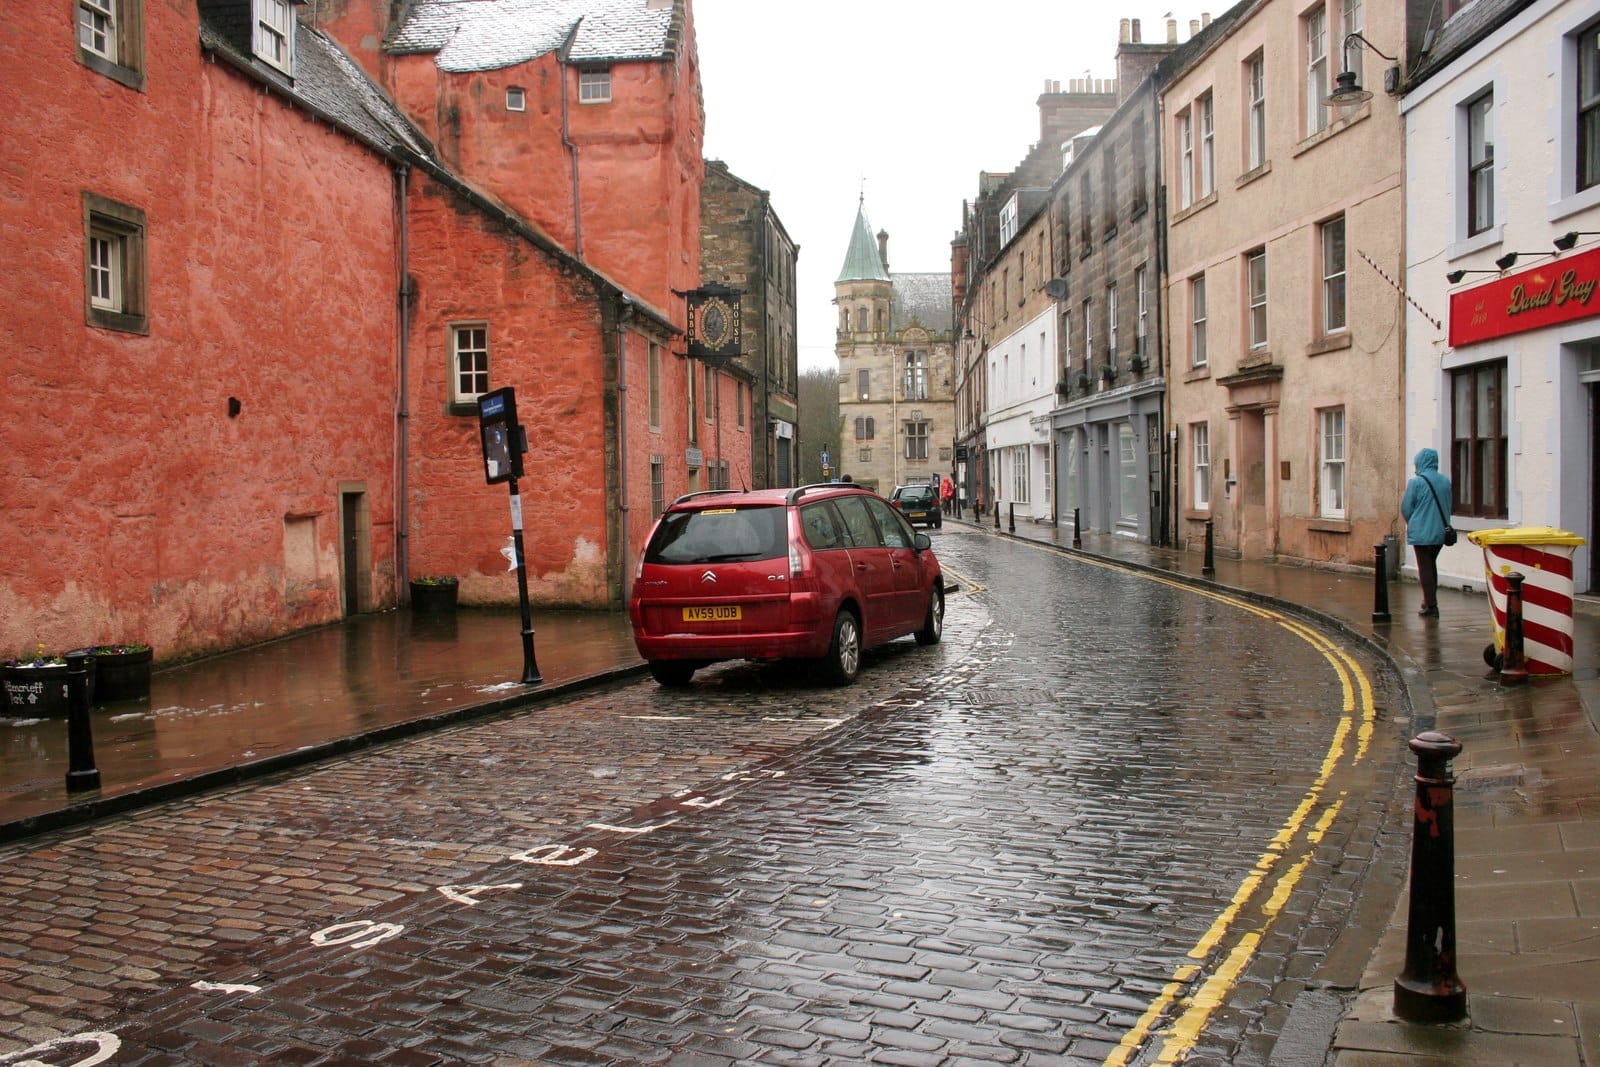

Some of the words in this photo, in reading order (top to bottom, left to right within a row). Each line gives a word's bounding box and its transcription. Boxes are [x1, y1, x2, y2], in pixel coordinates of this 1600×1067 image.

[1507, 281, 1555, 314] David
[1556, 269, 1595, 304] Gray
[688, 608, 715, 619] AV59
[716, 607, 738, 618] UDB
